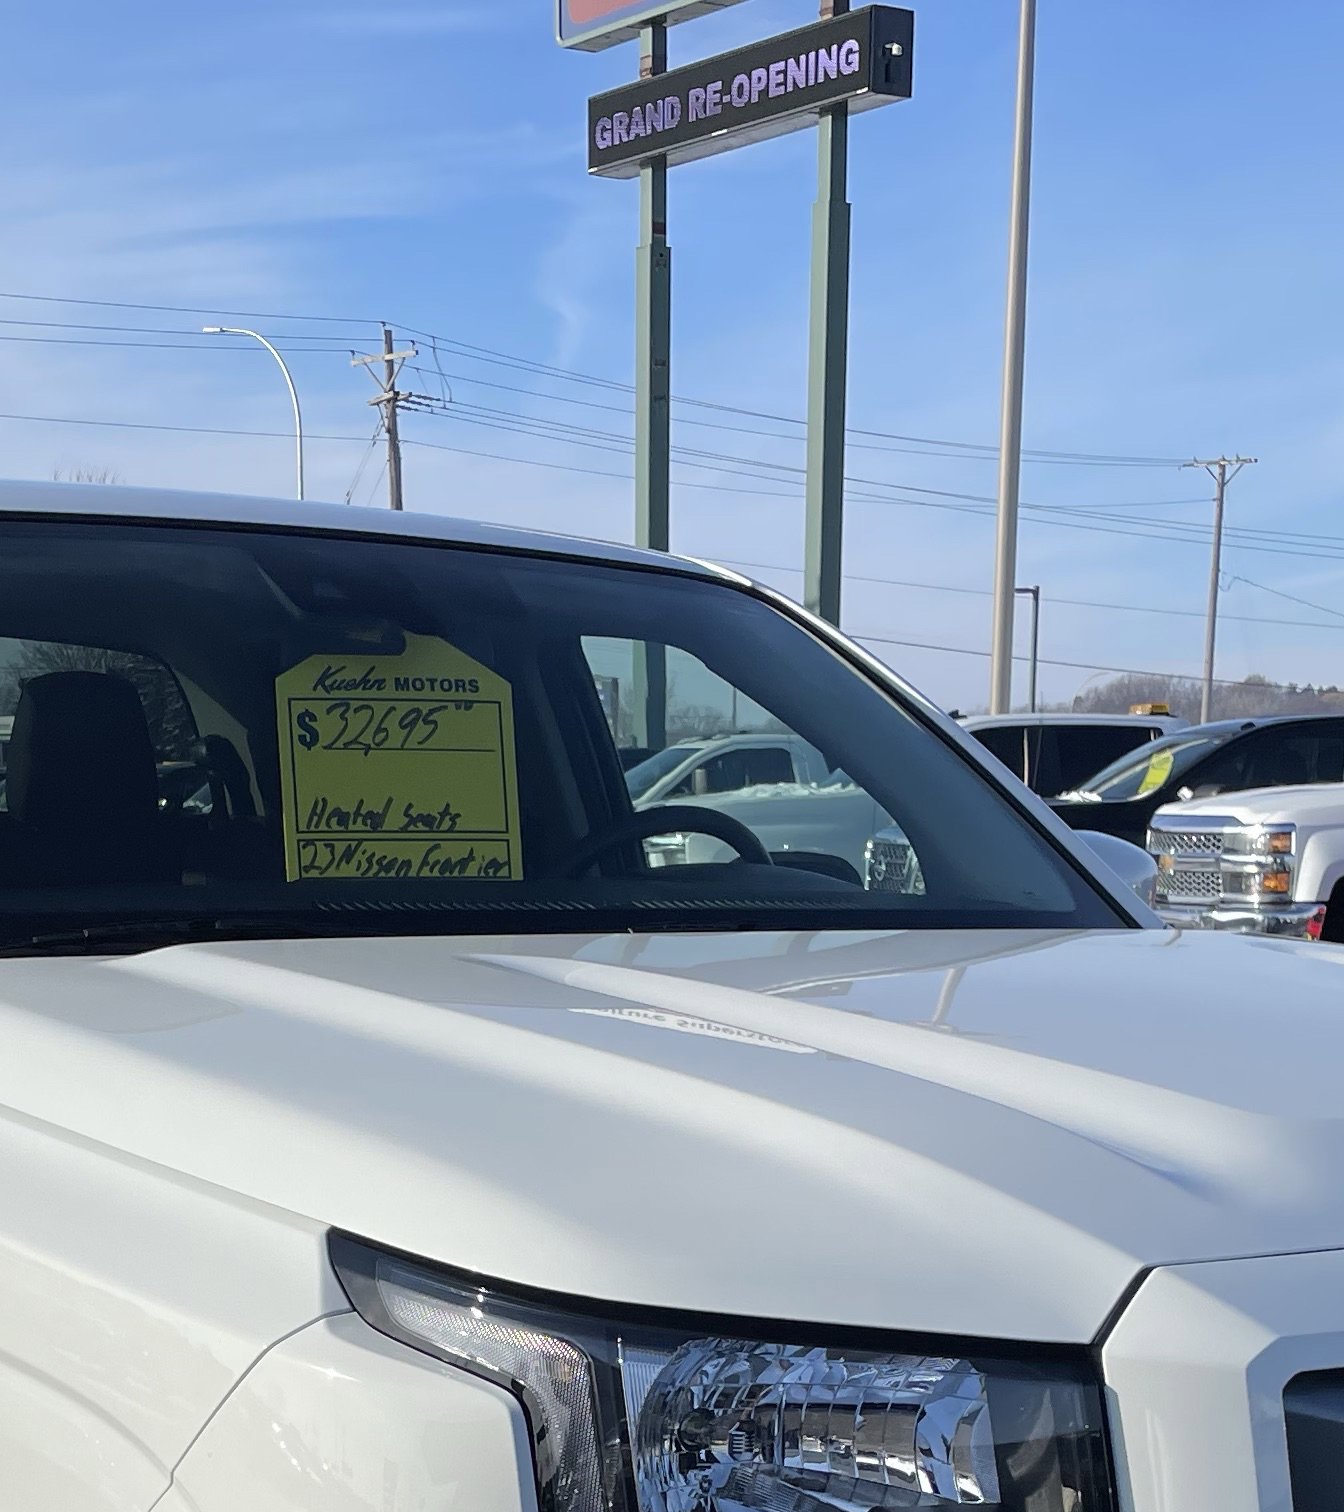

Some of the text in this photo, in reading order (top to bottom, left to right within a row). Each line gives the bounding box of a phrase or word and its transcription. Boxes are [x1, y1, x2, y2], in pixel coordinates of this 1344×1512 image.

[594, 39, 860, 149] GRAND RE-OPENING
[312, 664, 480, 695] Kuehn MOTORS
[306, 796, 394, 831] Heated
[301, 841, 336, 875] 23
